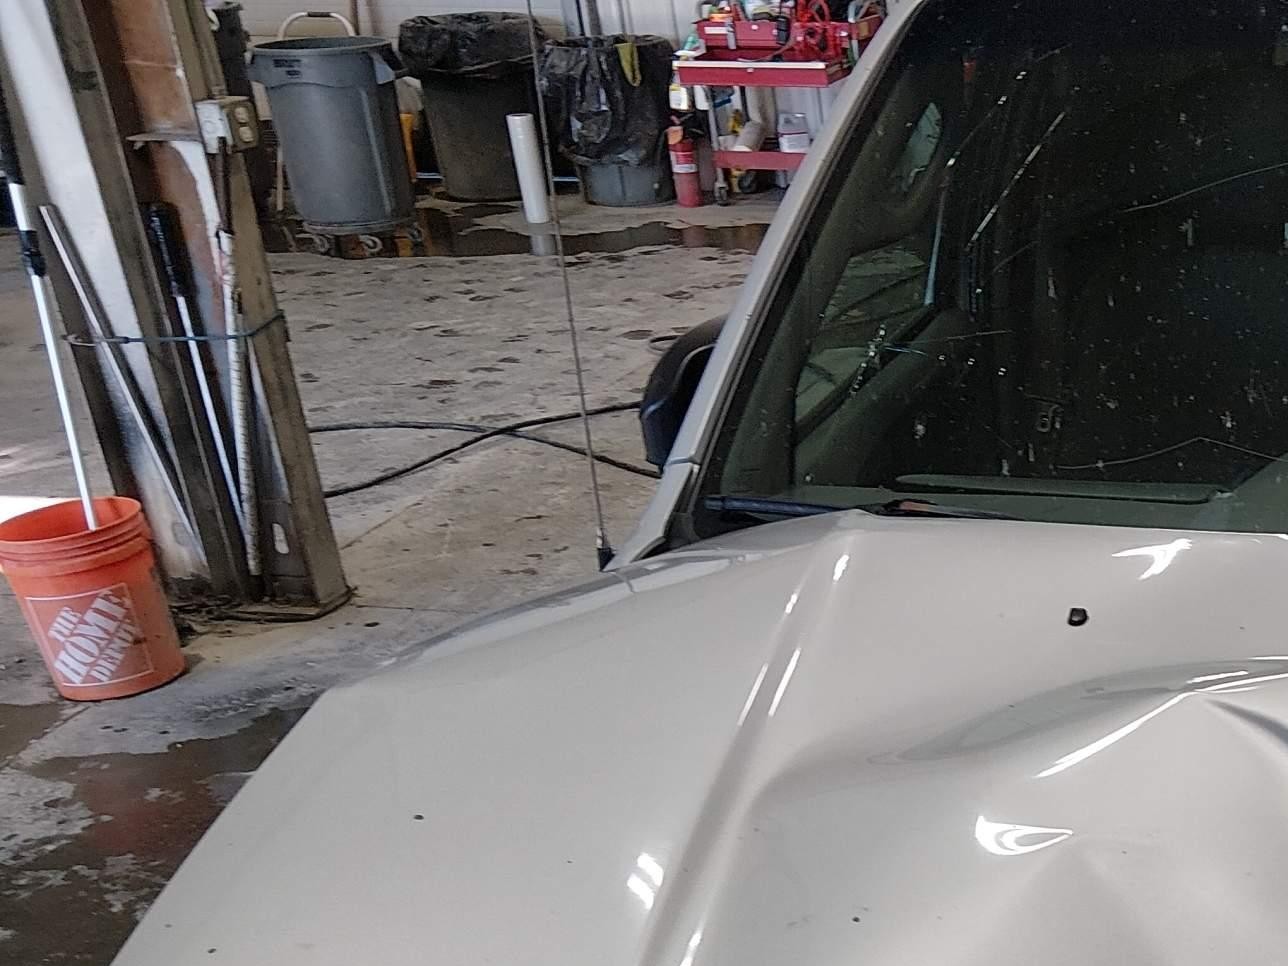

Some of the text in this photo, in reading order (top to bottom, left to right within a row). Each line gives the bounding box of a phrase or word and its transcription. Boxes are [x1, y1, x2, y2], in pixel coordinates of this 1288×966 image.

[48, 606, 82, 643] THE
[54, 590, 131, 684] HOME
[90, 618, 145, 682] DEPOT
